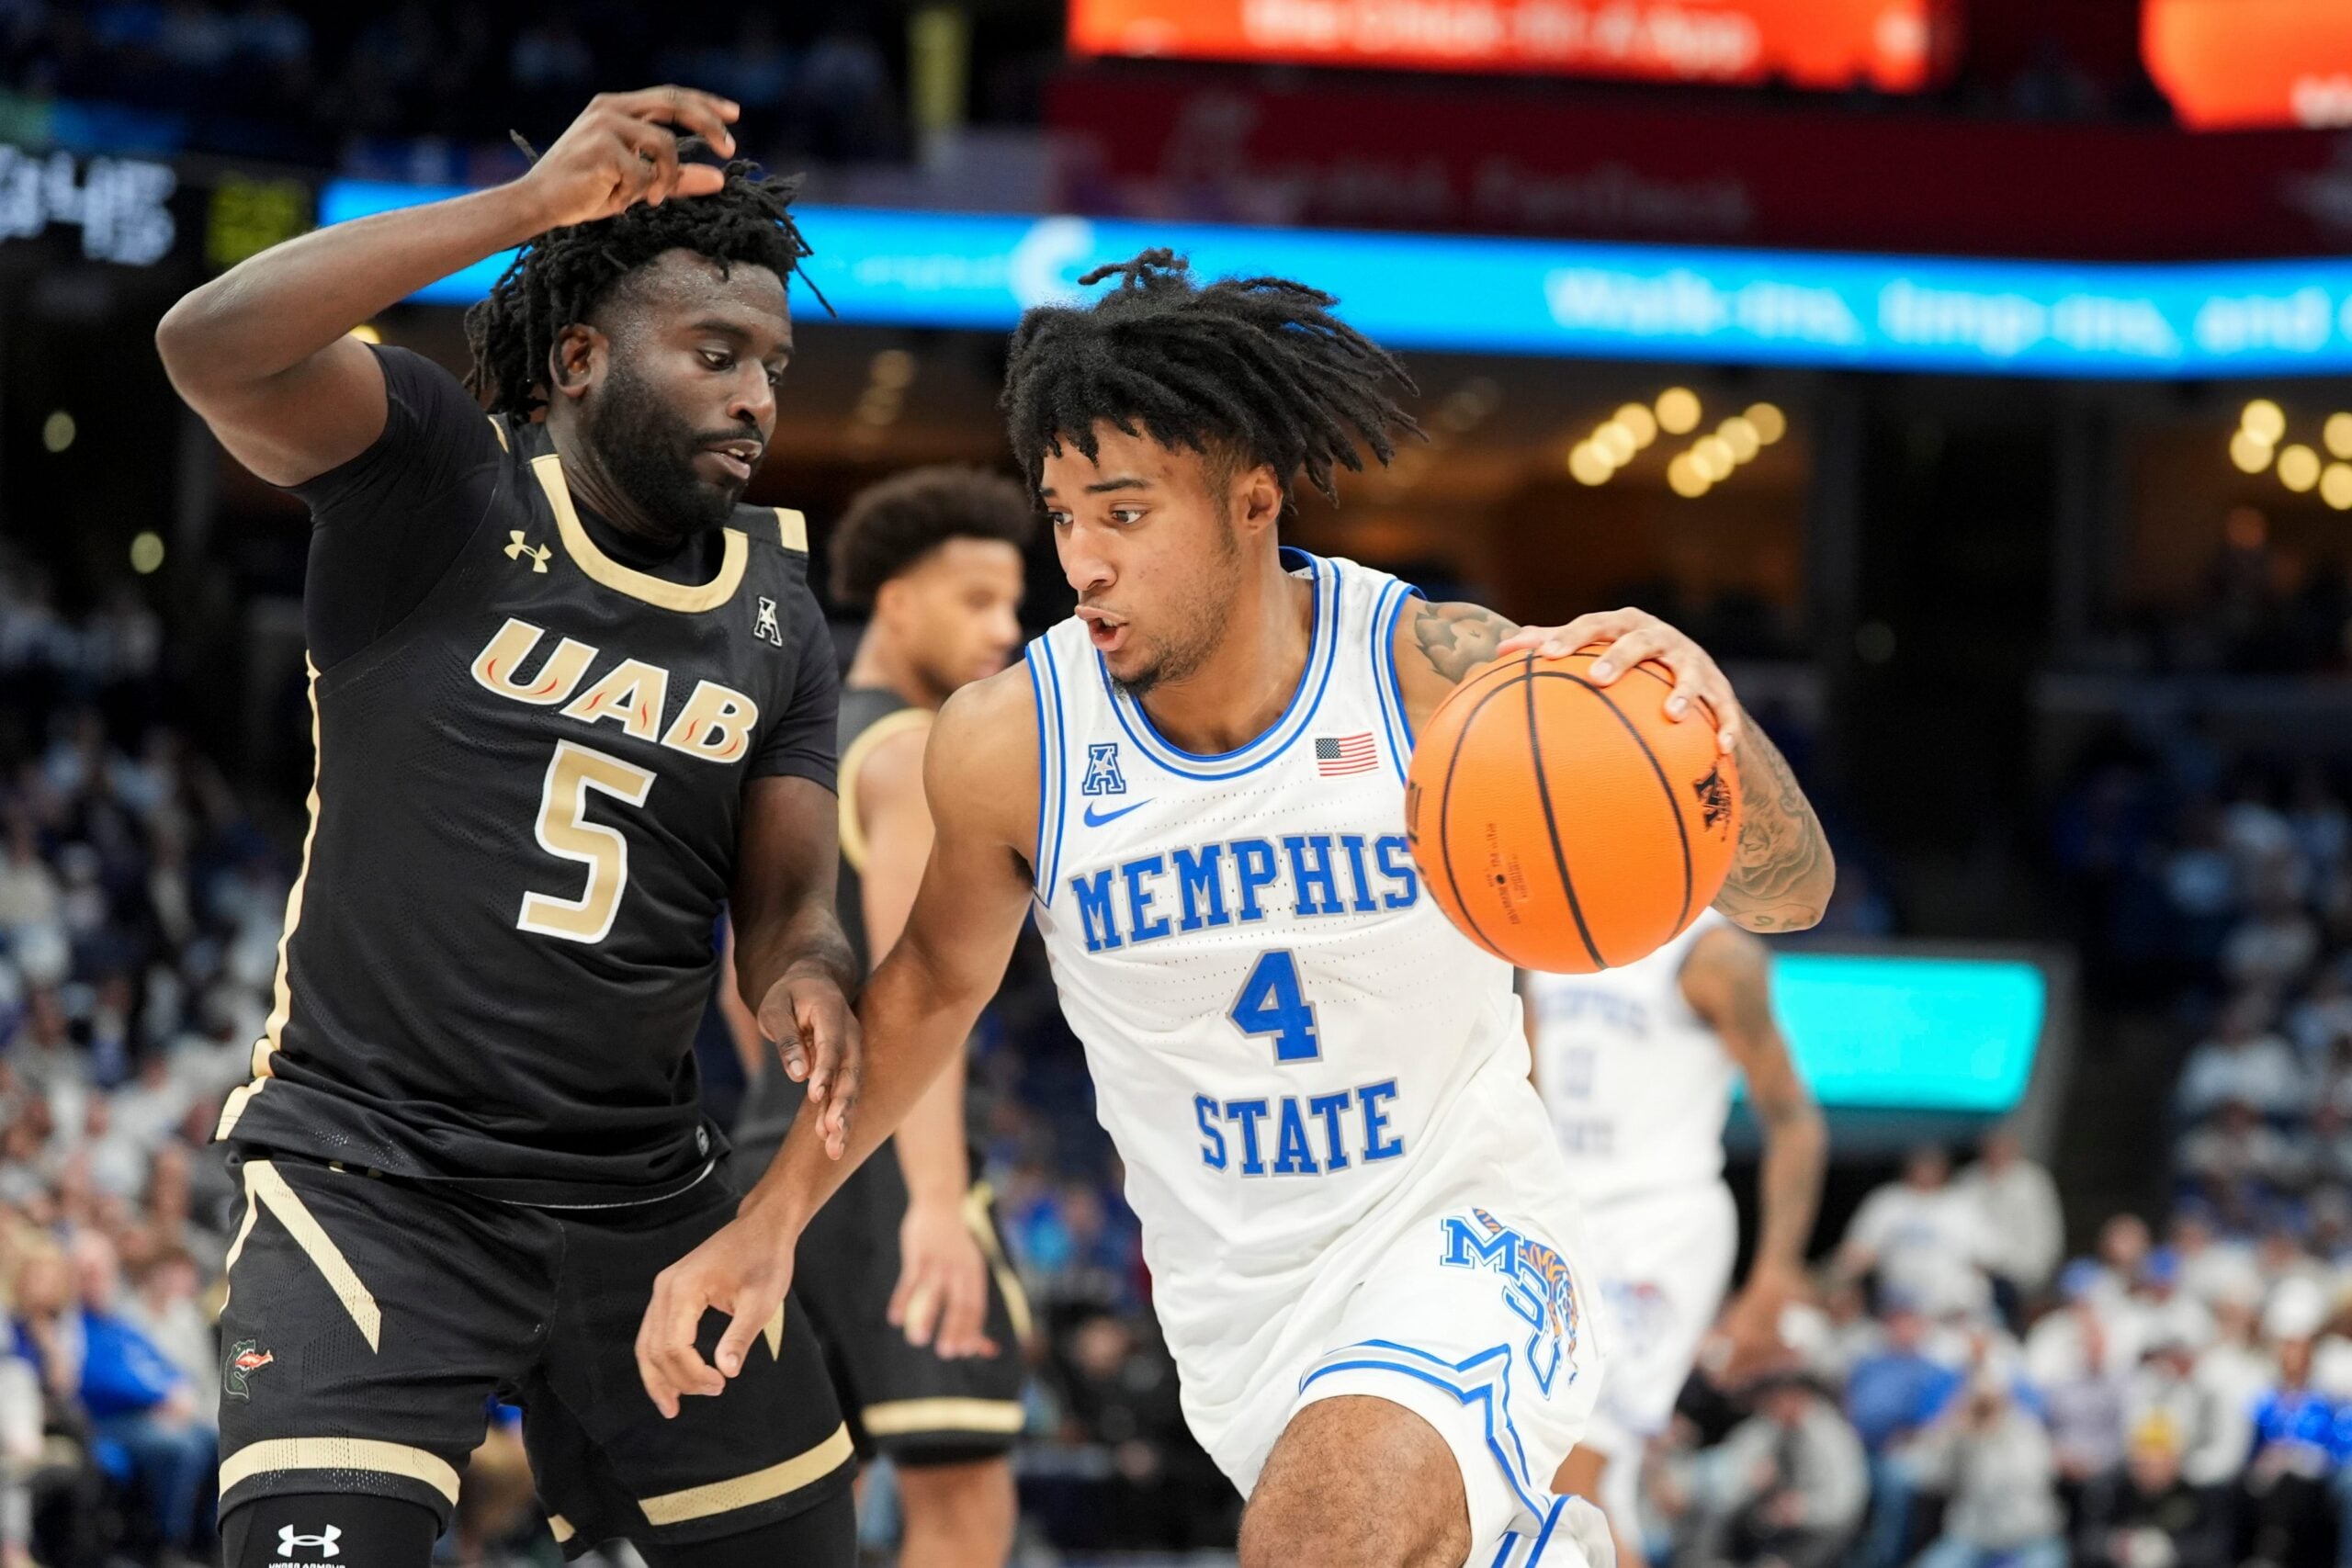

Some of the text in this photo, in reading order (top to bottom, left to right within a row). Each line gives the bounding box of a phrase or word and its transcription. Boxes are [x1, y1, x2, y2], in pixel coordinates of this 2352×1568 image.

[470, 617, 760, 763] UAB
[516, 738, 658, 944] 5
[1069, 832, 1421, 955] MEMPHIS
[1225, 947, 1324, 1066] 4
[1192, 1077, 1406, 1179] STATE
